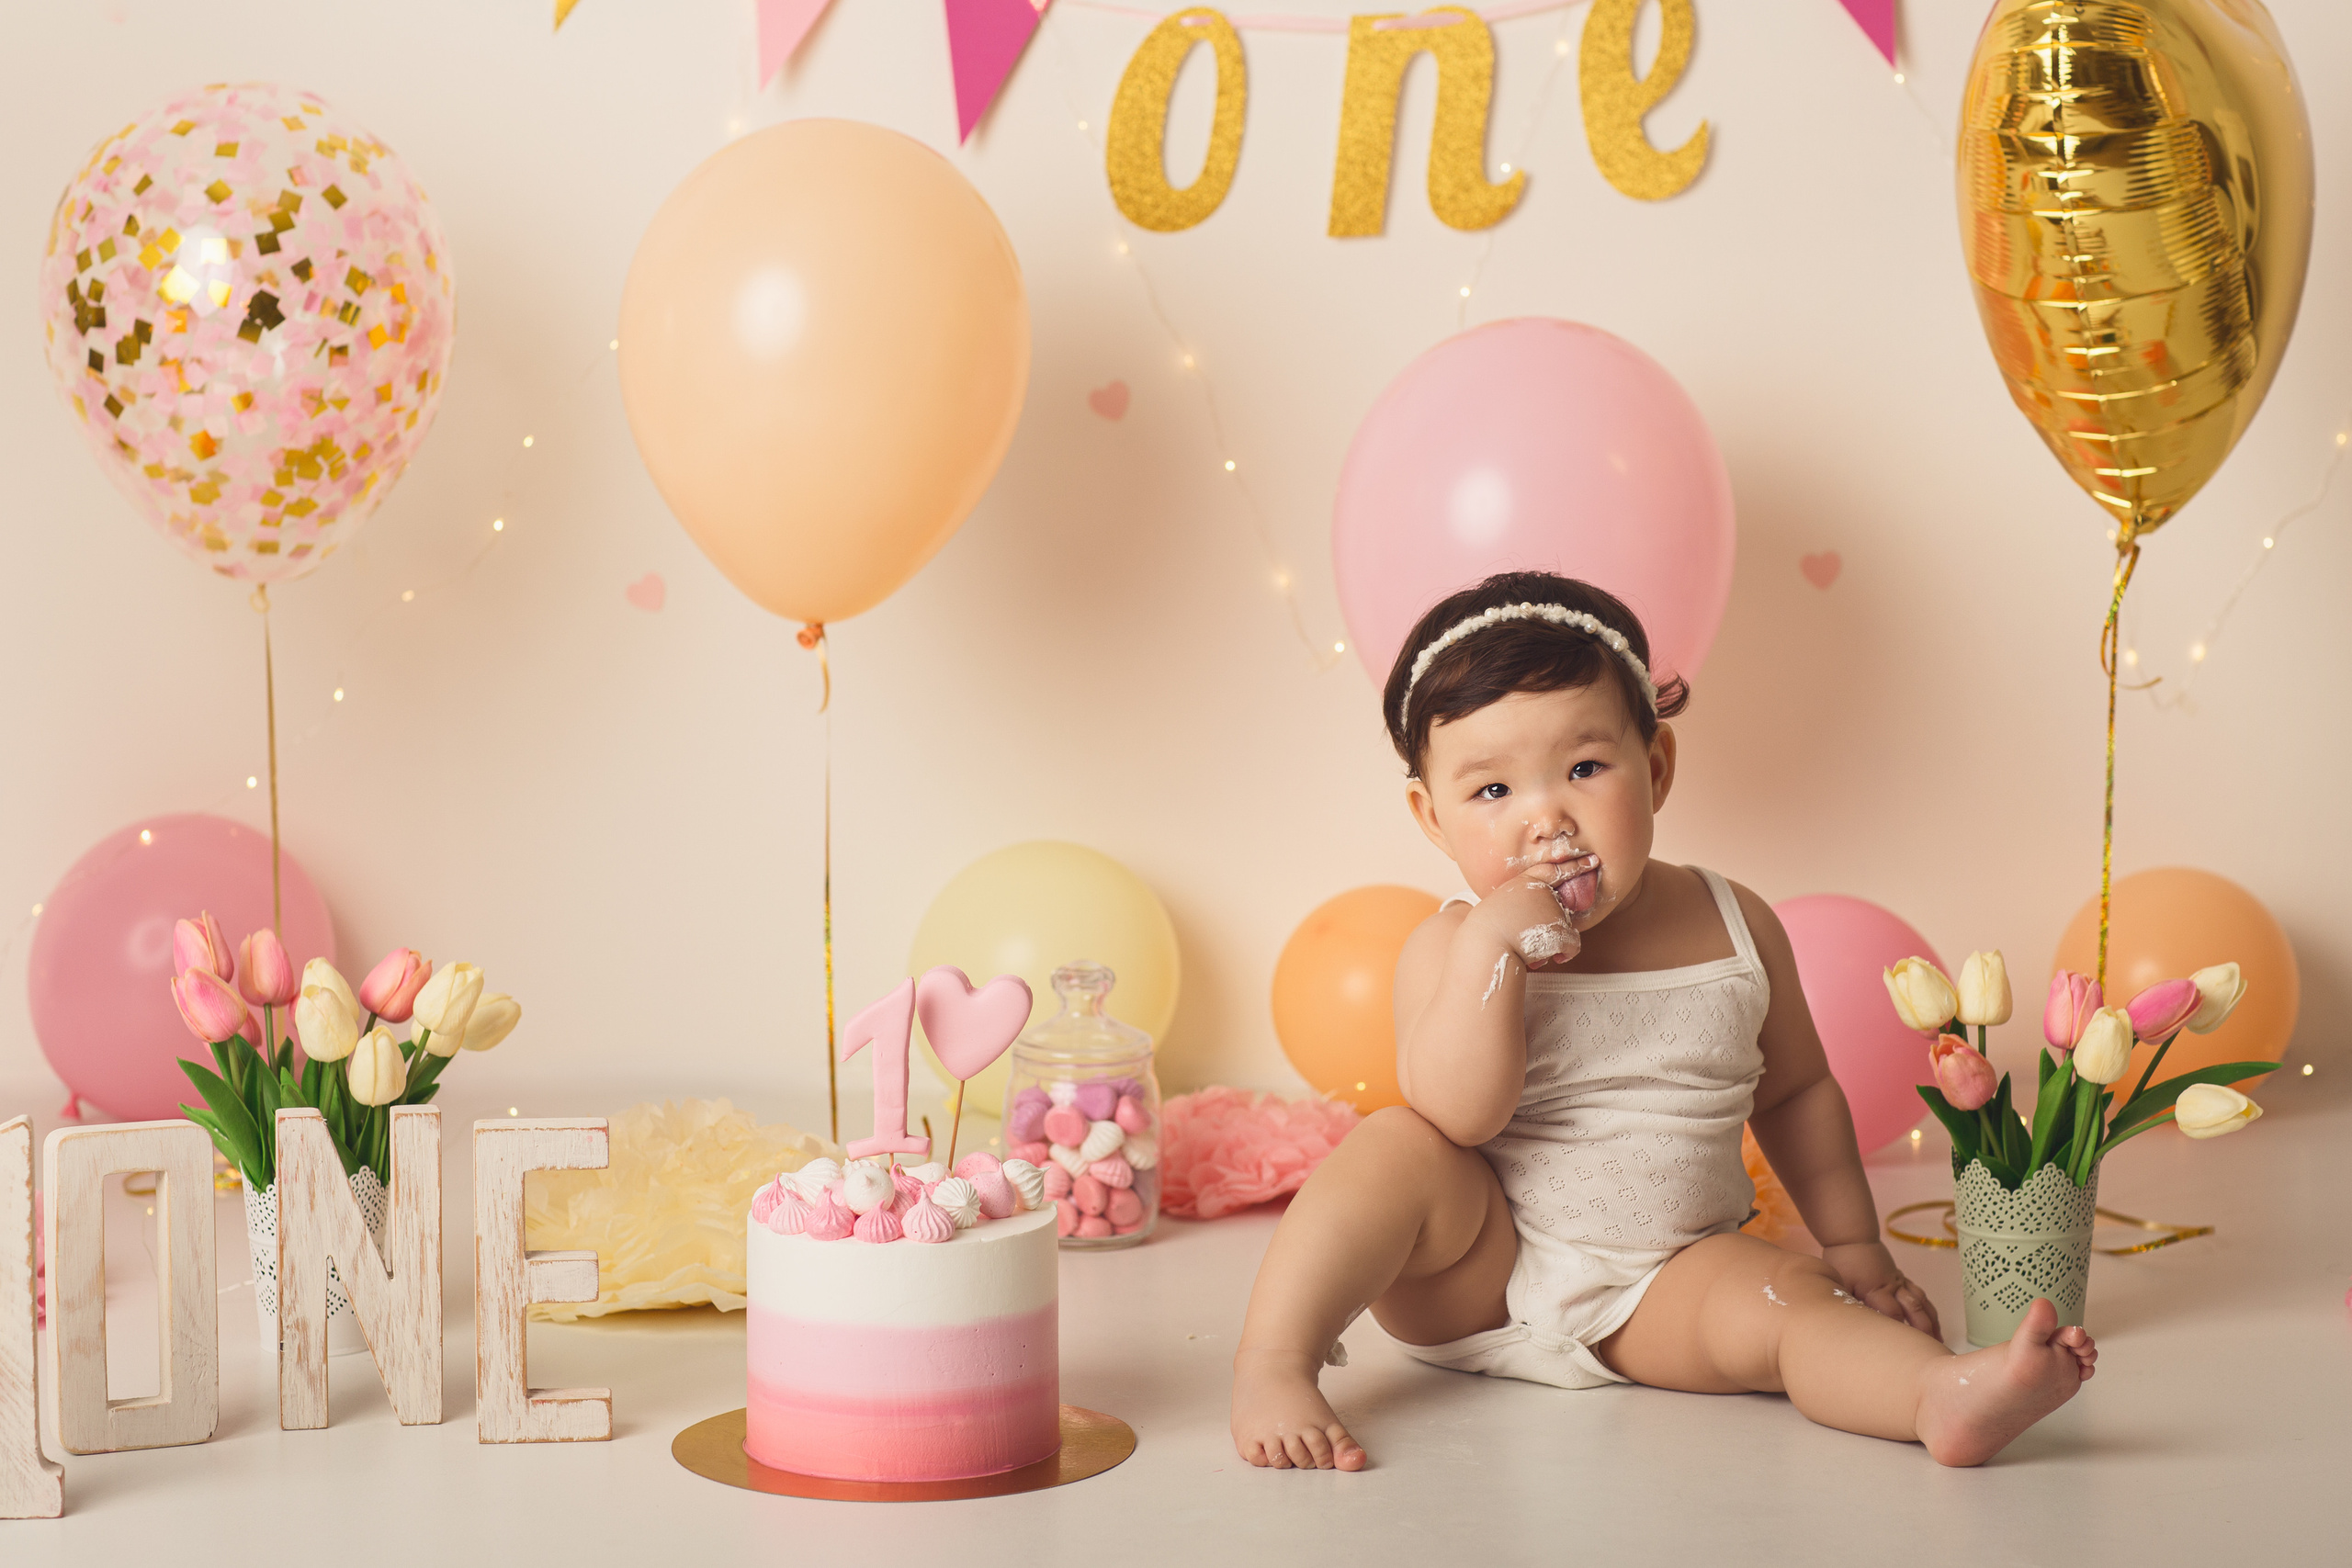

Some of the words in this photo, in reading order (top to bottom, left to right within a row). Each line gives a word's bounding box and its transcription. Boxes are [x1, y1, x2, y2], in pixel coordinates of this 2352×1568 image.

[1106, 0, 1710, 237] one
[841, 976, 931, 1159] 1
[44, 1105, 613, 1455] ONE
